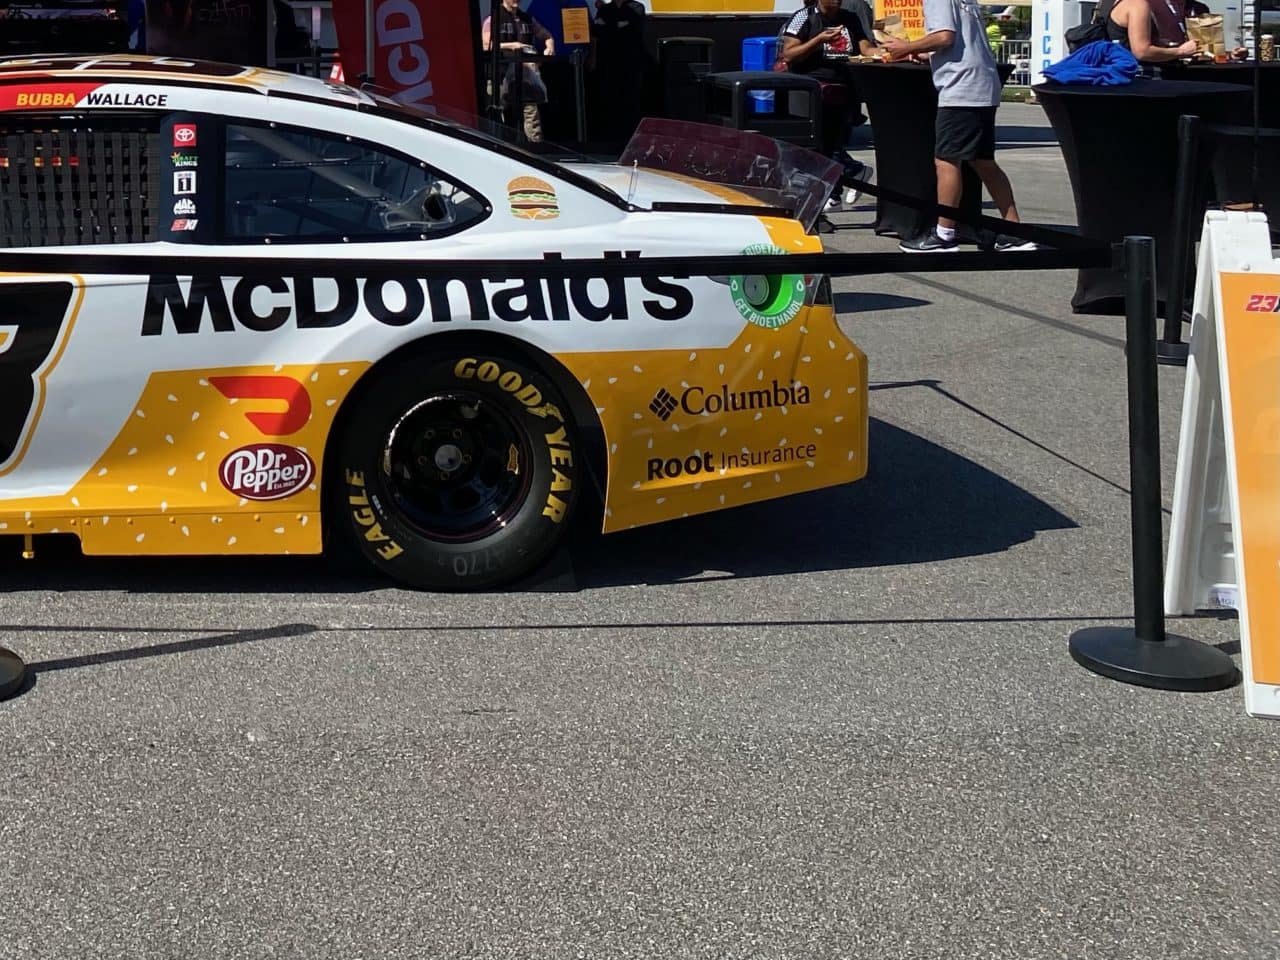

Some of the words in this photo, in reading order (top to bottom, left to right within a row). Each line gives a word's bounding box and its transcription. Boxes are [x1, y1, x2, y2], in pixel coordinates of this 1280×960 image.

[16, 93, 77, 106] BUBBA
[86, 93, 168, 106] WALLACE
[141, 250, 694, 337] McDonald's
[735, 299, 751, 315] GET
[749, 299, 803, 327] BIOETHANOL
[681, 379, 811, 415] Columbia
[224, 450, 305, 493] Pepper
[256, 448, 287, 471] Dr
[647, 450, 715, 481] Root
[720, 443, 817, 470] Insurance
[346, 467, 404, 561] EAGLE
